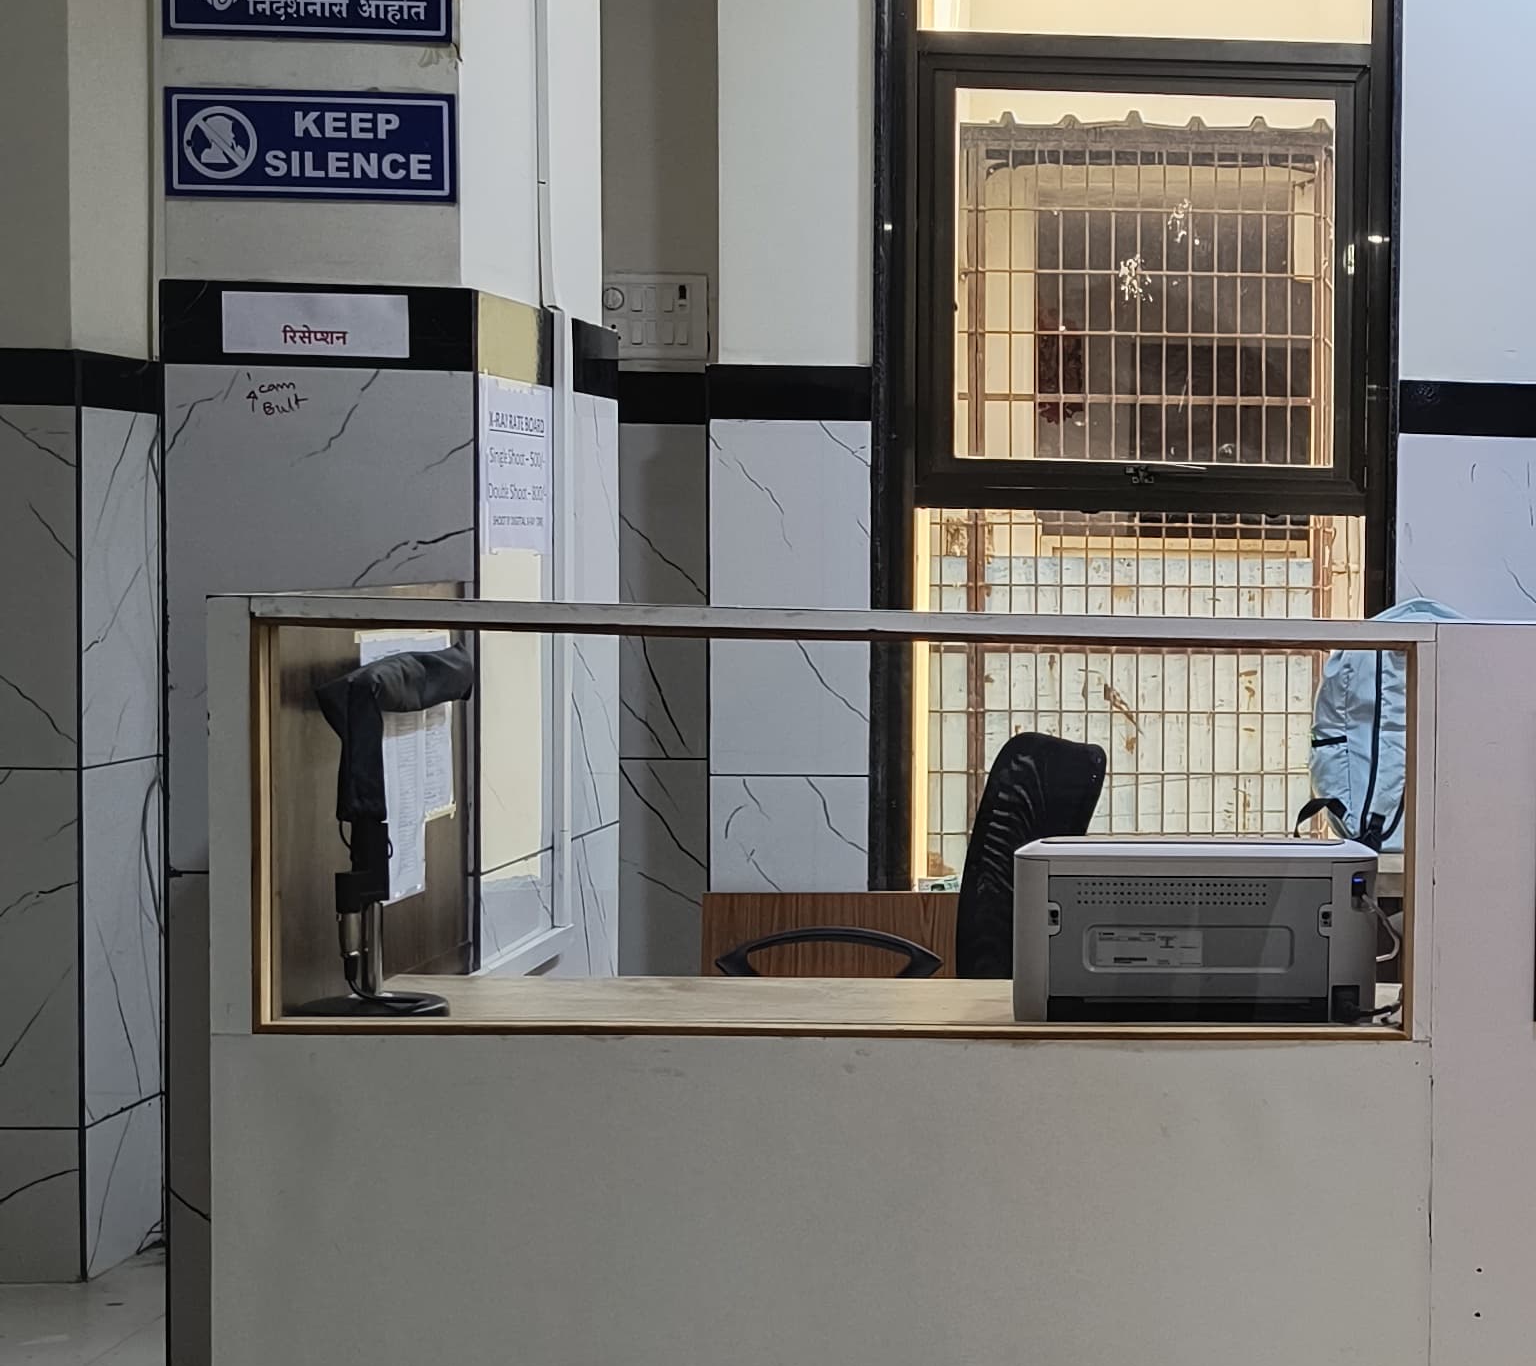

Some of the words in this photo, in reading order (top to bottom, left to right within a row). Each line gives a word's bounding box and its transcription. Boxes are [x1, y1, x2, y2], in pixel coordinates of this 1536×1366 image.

[294, 111, 400, 139] KEEP
[264, 150, 432, 180] SILENCE
[282, 324, 348, 345] रिसेप्शन
